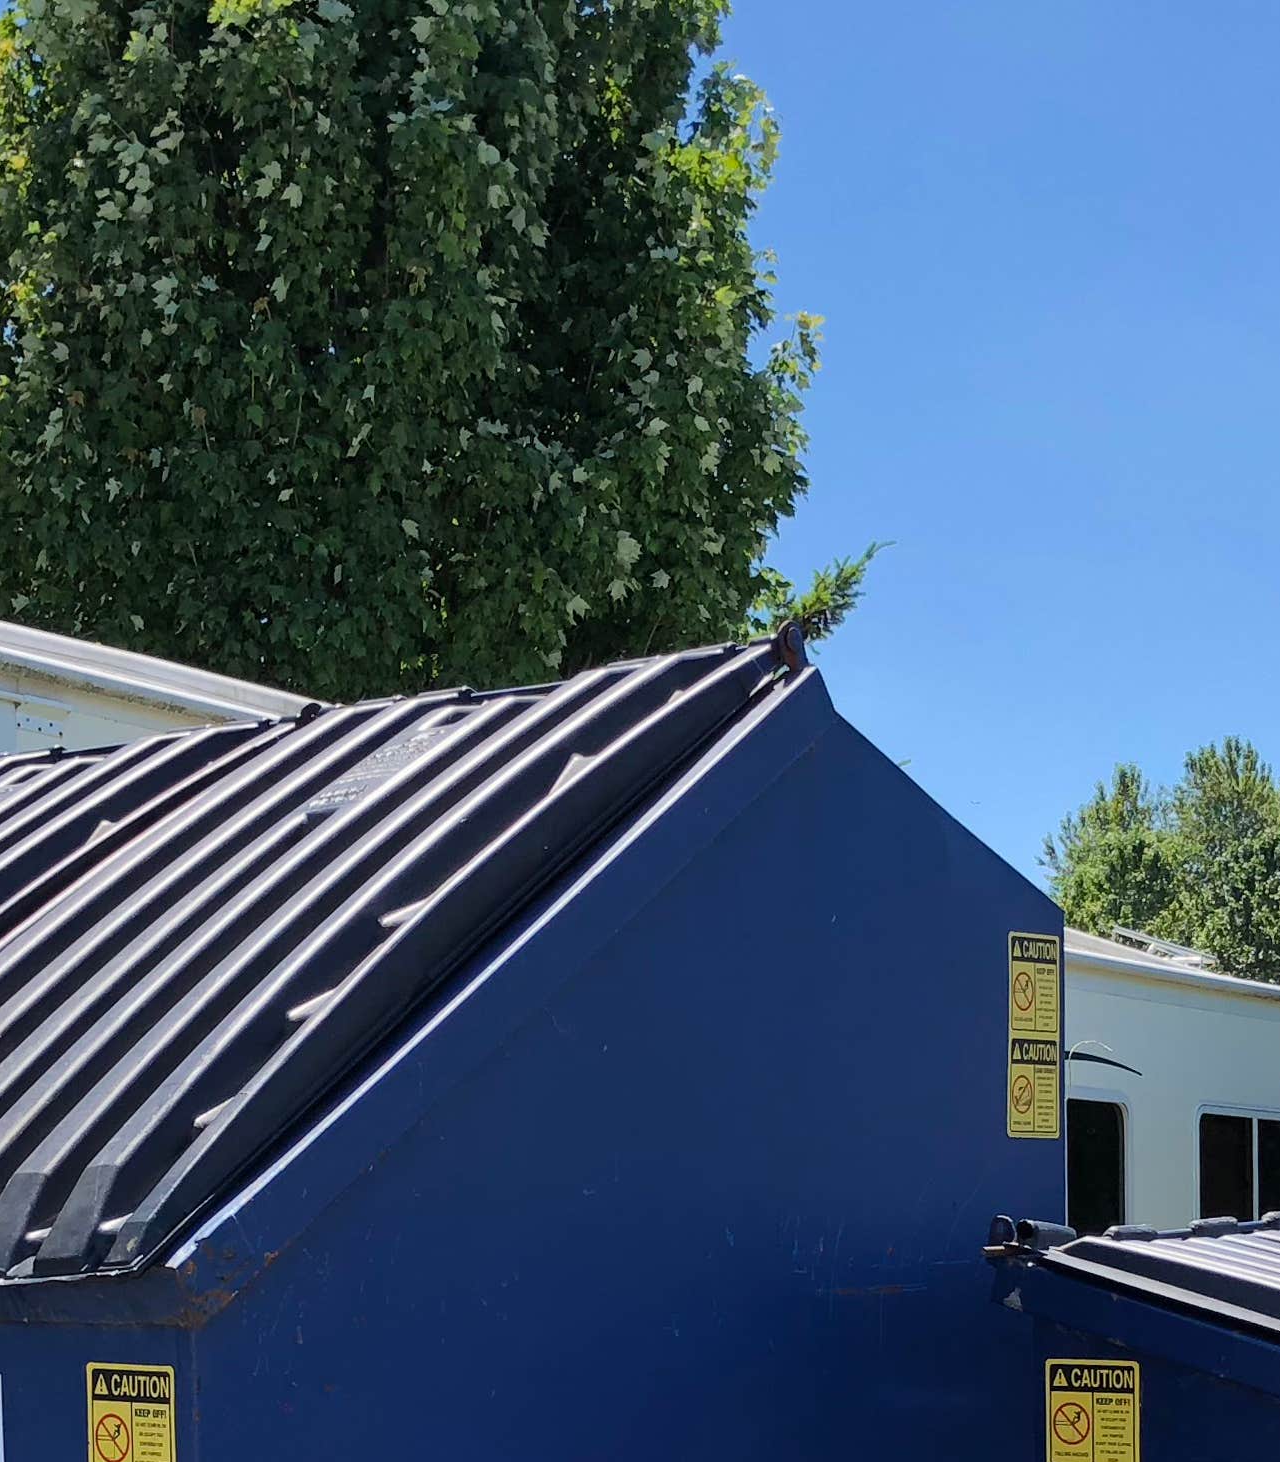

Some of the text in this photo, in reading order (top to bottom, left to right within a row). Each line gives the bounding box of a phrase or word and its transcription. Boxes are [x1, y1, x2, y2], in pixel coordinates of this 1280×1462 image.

[1022, 941, 1057, 960] CAUTION
[1022, 1044, 1057, 1062] CAUTION
[111, 1374, 169, 1398] CAUTION
[1070, 1368, 1133, 1389] CAUTION
